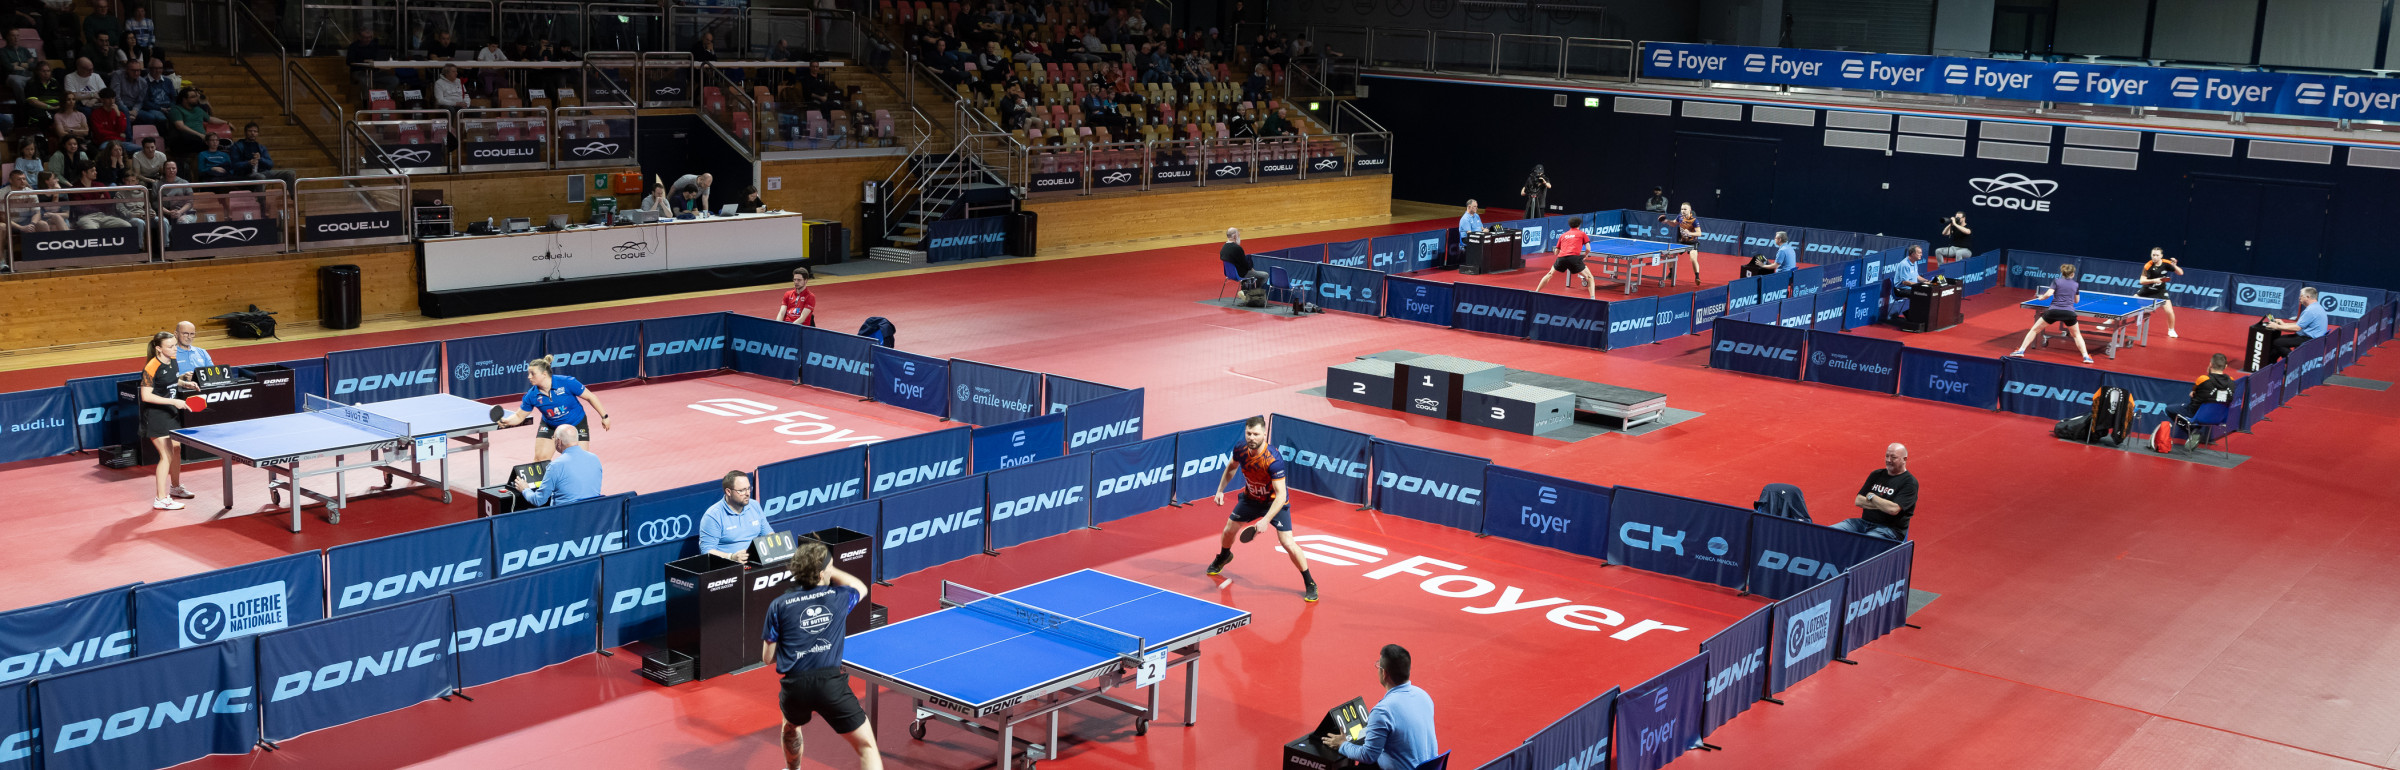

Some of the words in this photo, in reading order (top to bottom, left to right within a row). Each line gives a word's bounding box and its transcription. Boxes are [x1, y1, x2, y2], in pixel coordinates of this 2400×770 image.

[1678, 50, 1727, 74] Foyer
[1771, 55, 1823, 80] Foyer
[1870, 60, 1925, 86] Foyer
[1974, 66, 2033, 92] Foyer
[2086, 72, 2149, 99] Foyer
[2205, 78, 2273, 106] Foyer
[2332, 85, 2400, 114] Foyer
[473, 147, 534, 158] COQUE.LU
[1357, 158, 1385, 166] COQUE.LU
[1157, 169, 1191, 179] COQUE.LU
[1263, 163, 1294, 172] COQUE.LU
[1036, 177, 1075, 187] COQUE.LU
[1972, 194, 2051, 212] COQUE
[318, 220, 390, 234] COQUE.LU
[36, 237, 125, 251] COQUE.LU
[930, 236, 978, 248] DONIC
[1805, 243, 1862, 257] DONIC
[614, 251, 646, 260] COQUE
[1372, 252, 1394, 267] CK
[1319, 282, 1352, 301] CK
[2080, 273, 2144, 289] DONIC
[1729, 294, 1758, 309] DONIC
[2257, 297, 2281, 305] NATIONALE
[2258, 290, 2282, 300] LOTERIE
[2339, 299, 2365, 308] LOTERIE
[1406, 298, 1434, 315] Foyer
[1456, 302, 1527, 321] DONIC
[1816, 306, 1844, 324] DONIC
[1854, 306, 1870, 320] Foyer
[2338, 306, 2364, 314] NATIONALE
[1532, 313, 1605, 332] DONIC
[1610, 316, 1654, 334] DONIC
[550, 344, 636, 368] DONIC
[647, 335, 726, 357] DONIC
[731, 337, 799, 361] DONIC
[1715, 340, 1798, 362] DONIC
[2251, 331, 2265, 373] DONIC
[199, 369, 207, 382] 5
[208, 367, 213, 376] 0
[215, 366, 221, 375] 0
[223, 367, 231, 379] 2
[474, 364, 505, 379] emile
[507, 360, 530, 375] web
[806, 351, 874, 377] DONIC
[1829, 358, 1858, 371] emile
[1860, 361, 1893, 376] weber
[263, 377, 290, 385] DONIC
[335, 368, 437, 396] DONIC
[894, 377, 925, 399] Foyer
[1352, 382, 1366, 395] 2
[1422, 375, 1434, 387] 1
[1929, 374, 1969, 396] Foyer
[972, 392, 1000, 409] emile
[1000, 397, 1034, 415] weber
[2002, 380, 2094, 406] DONIC
[1415, 403, 1438, 413] COQUE
[1490, 407, 1506, 420] 3
[11, 416, 65, 433] audi.lu
[737, 410, 886, 447] Foy
[1071, 416, 1141, 448] DONIC
[231, 455, 252, 466] DONIC
[428, 445, 434, 456] 1
[261, 456, 300, 467] DONIC
[1181, 451, 1232, 479] DON
[1278, 444, 1368, 479] DONIC
[519, 469, 527, 482] 5
[529, 466, 534, 476] 0
[536, 465, 542, 475] 0
[873, 457, 963, 494] DONIC
[1097, 463, 1174, 499] DONIC
[763, 477, 862, 518] DONIC
[1376, 470, 1481, 505] DONIC
[1872, 483, 1895, 496] HUGO
[992, 485, 1084, 522] DONIC
[883, 506, 983, 550] DONIC
[1521, 506, 1571, 534] Foyer
[759, 540, 768, 556] 0
[767, 536, 774, 548] 0
[775, 535, 782, 547] 0
[784, 535, 792, 551] 0
[1619, 521, 1686, 556] CK
[501, 529, 628, 575] DONIC
[840, 547, 868, 560] DONIC
[1695, 554, 1716, 563] KONICA
[1716, 558, 1739, 568] MINOLTA
[1757, 549, 1840, 581] DON
[338, 557, 482, 610] DONIC
[670, 577, 695, 590] DONIC
[707, 576, 738, 590] DONIC
[753, 570, 797, 591] DON
[230, 593, 281, 619] LOTERIE
[785, 597, 800, 605] LUKA
[1362, 555, 1690, 641] Foyer
[1845, 578, 1906, 625] DONIC
[230, 613, 282, 633] NATIONALE
[448, 598, 589, 655] DONIC
[1216, 618, 1248, 636] DONIC
[1805, 612, 1829, 635] LOTERIE
[1805, 627, 1827, 649] NATIONALE
[0, 628, 136, 683] ONIC
[271, 638, 441, 703] DONIC
[1147, 663, 1156, 679] 2
[1703, 646, 1764, 702] DONIC
[929, 695, 971, 716] DONIC
[983, 696, 1023, 716] DONIC
[54, 685, 252, 754] DONIC
[1337, 714, 1347, 734] 0
[1342, 708, 1350, 722] 0
[1350, 705, 1357, 719] 0
[1358, 704, 1368, 723] 0
[1640, 715, 1677, 757] Foyer
[1553, 736, 1609, 770] NIC
